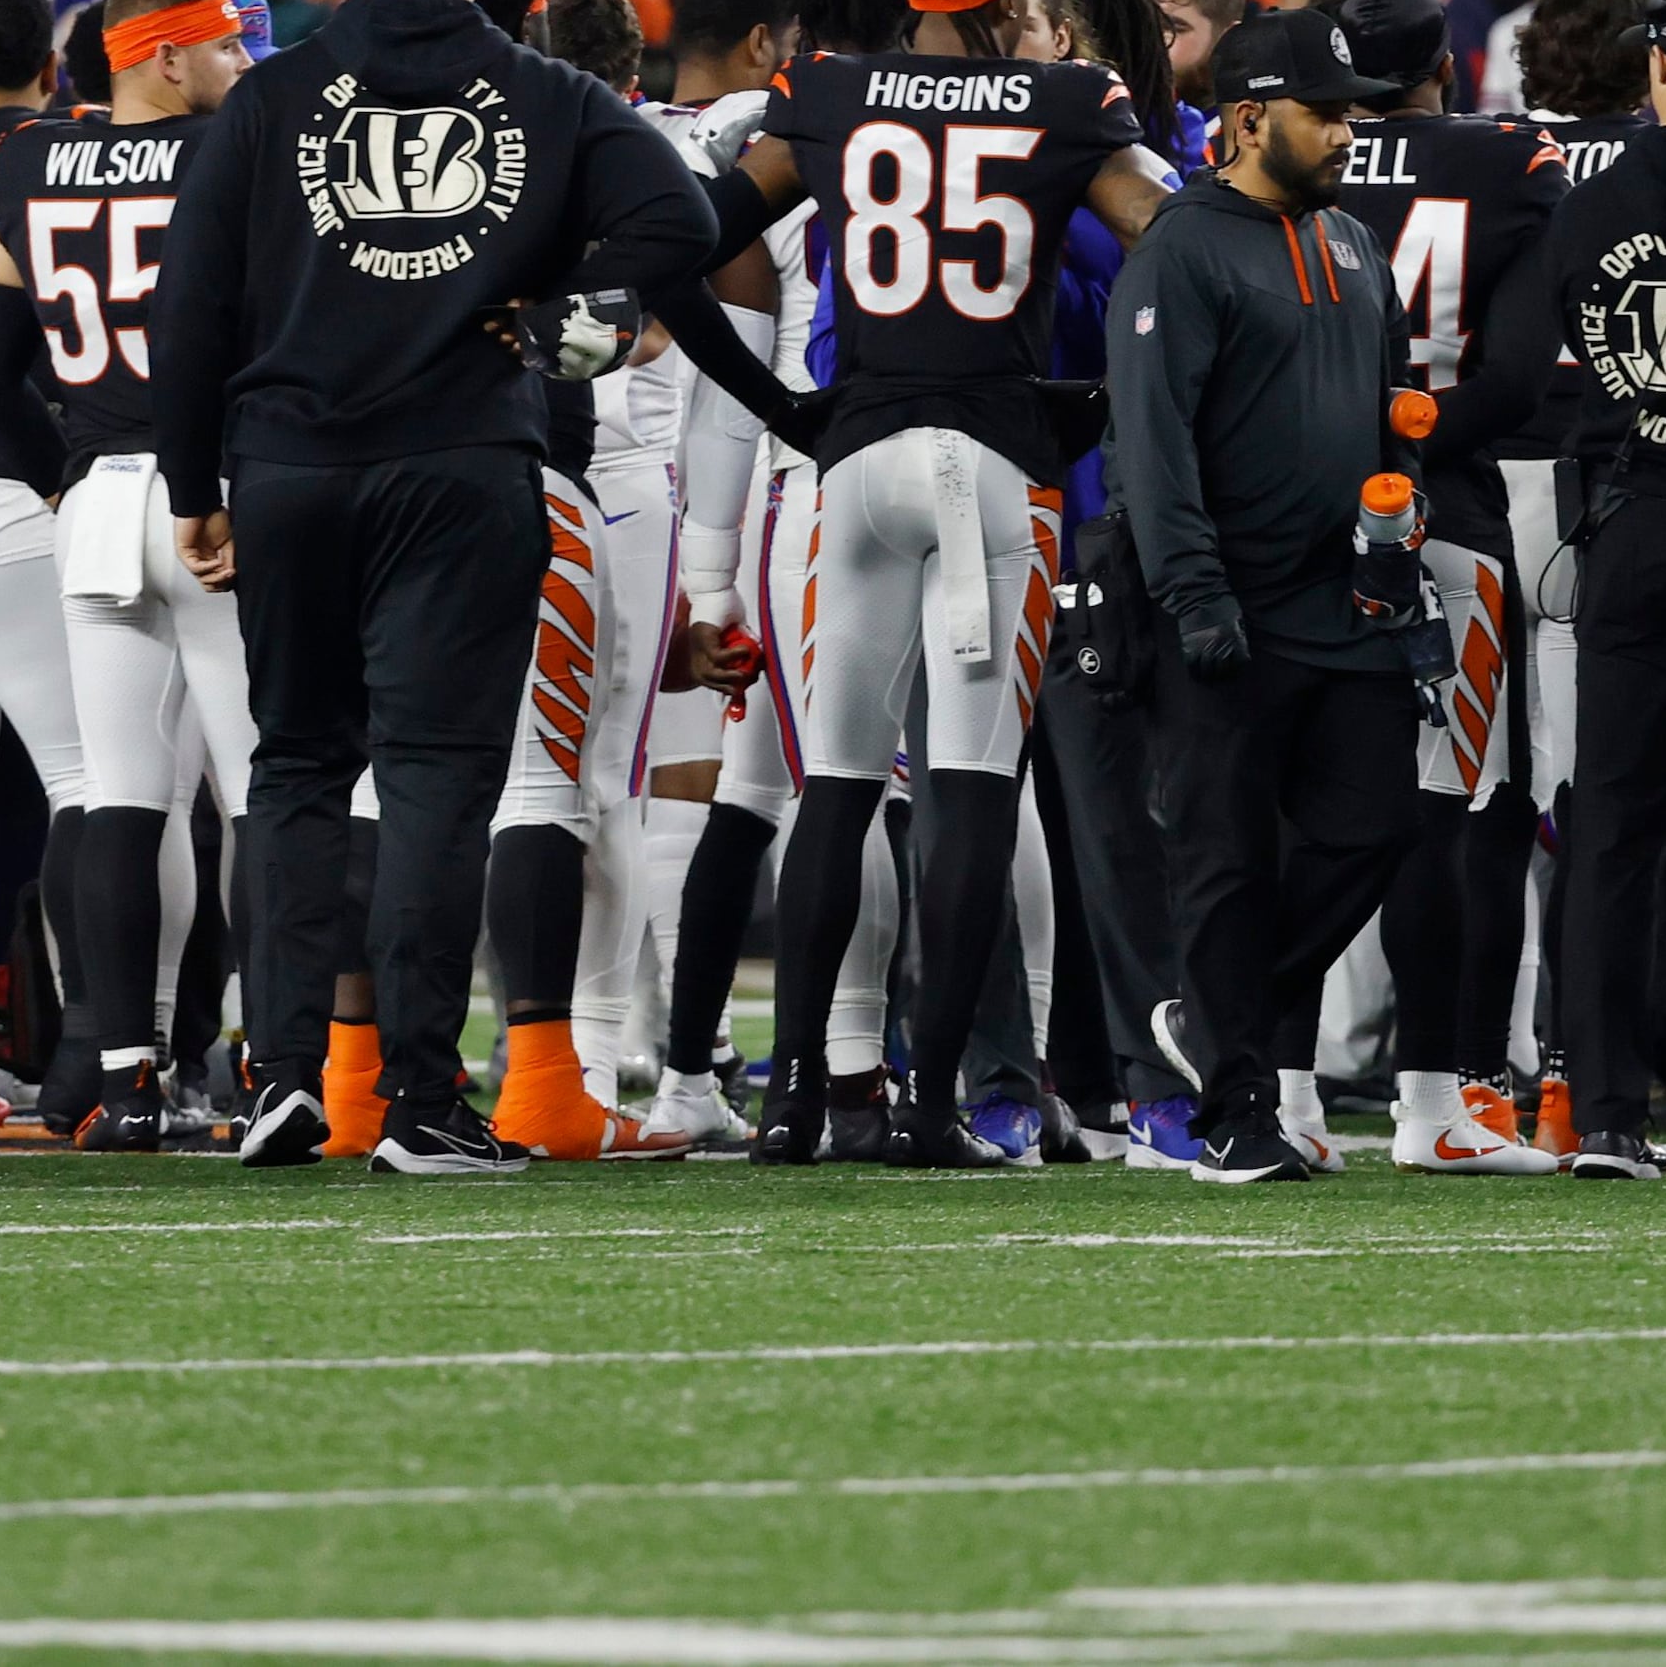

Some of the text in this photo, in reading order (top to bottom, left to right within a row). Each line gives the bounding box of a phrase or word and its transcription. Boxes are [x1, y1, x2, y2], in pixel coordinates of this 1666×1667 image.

[865, 71, 1033, 113] HIGGINS
[44, 139, 184, 186] WILSON
[296, 127, 528, 281] EQUITY FREEDOM JUSTICE
[841, 119, 1048, 322] 85
[26, 196, 178, 387] 55
[1580, 301, 1636, 401] JUSTICE
